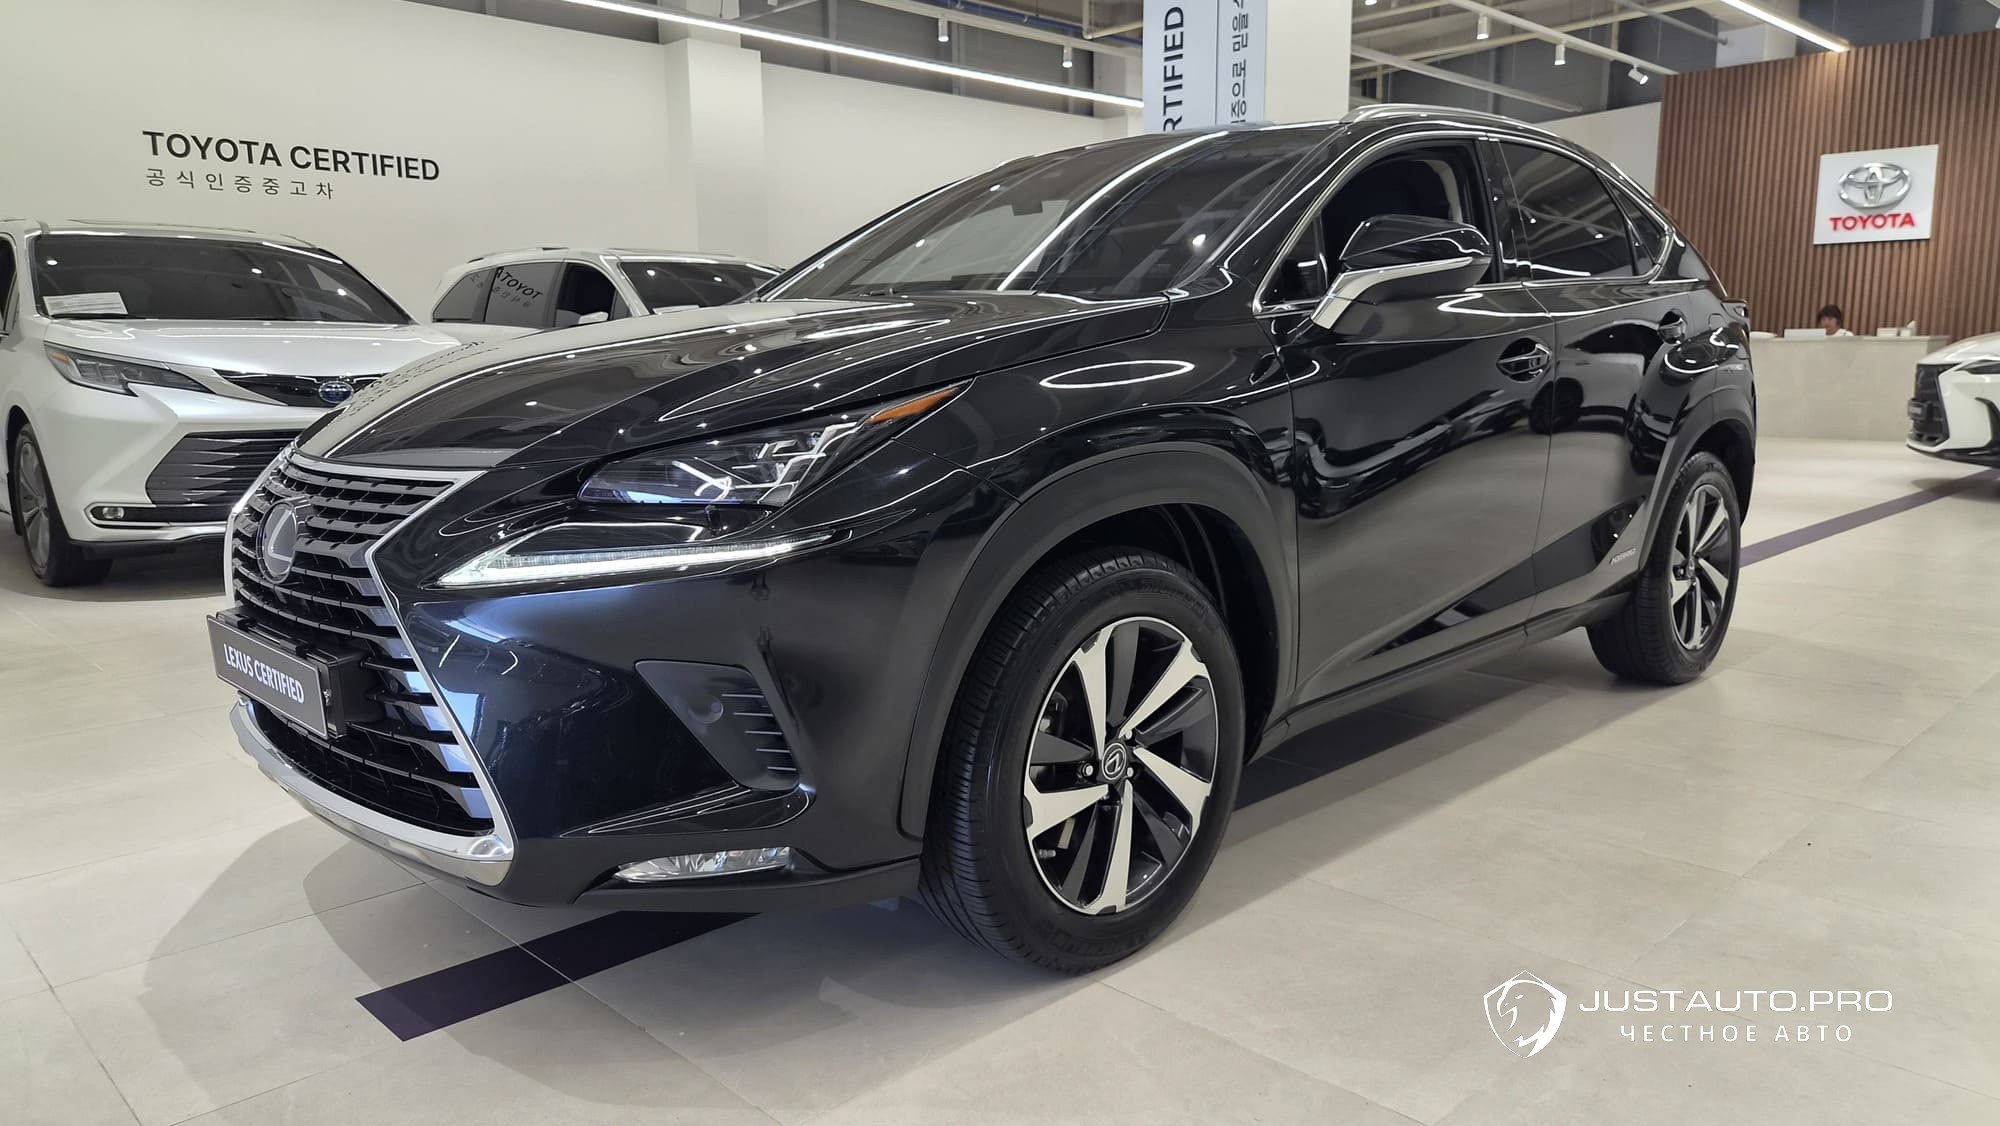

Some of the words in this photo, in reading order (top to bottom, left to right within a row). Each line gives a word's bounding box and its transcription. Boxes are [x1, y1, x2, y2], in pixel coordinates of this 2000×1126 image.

[1232, 13, 1249, 52] 믿을
[142, 130, 282, 167] TOYOTA
[289, 145, 440, 181] CERTIFIED
[146, 168, 334, 200] 공식인증중고차
[1829, 212, 1916, 231] TOYOTA
[223, 643, 254, 678] LEXUS
[253, 659, 305, 704] CERTIFIED
